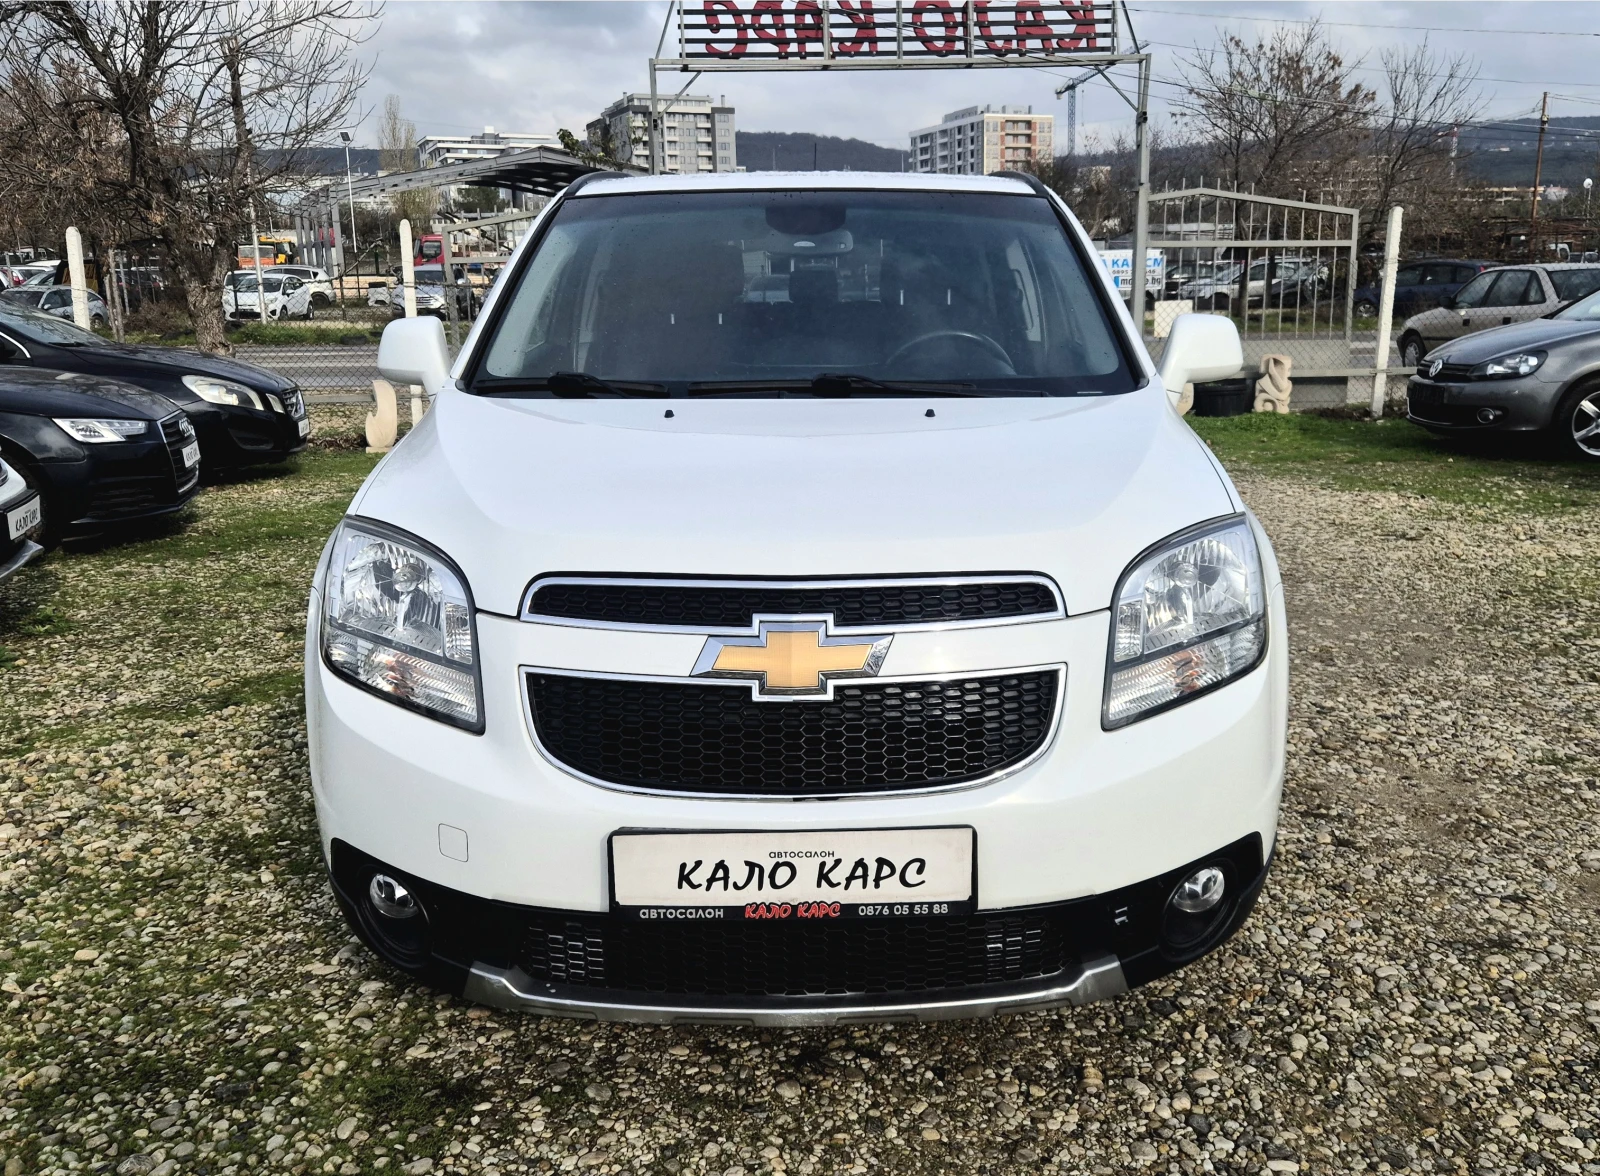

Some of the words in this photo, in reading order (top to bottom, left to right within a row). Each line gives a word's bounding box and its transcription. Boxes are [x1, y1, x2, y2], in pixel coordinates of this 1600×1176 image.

[1120, 276, 1161, 287] moe.bg
[768, 849, 835, 859] автосалон
[677, 859, 797, 891] КАЛО
[816, 857, 926, 890] КАРС
[639, 907, 724, 919] автосалон
[744, 903, 792, 919] КАЛО
[797, 902, 841, 918] КАРС
[858, 906, 889, 916] 0876
[893, 905, 910, 915] 05
[913, 904, 931, 914] 55
[933, 903, 949, 914] 88
